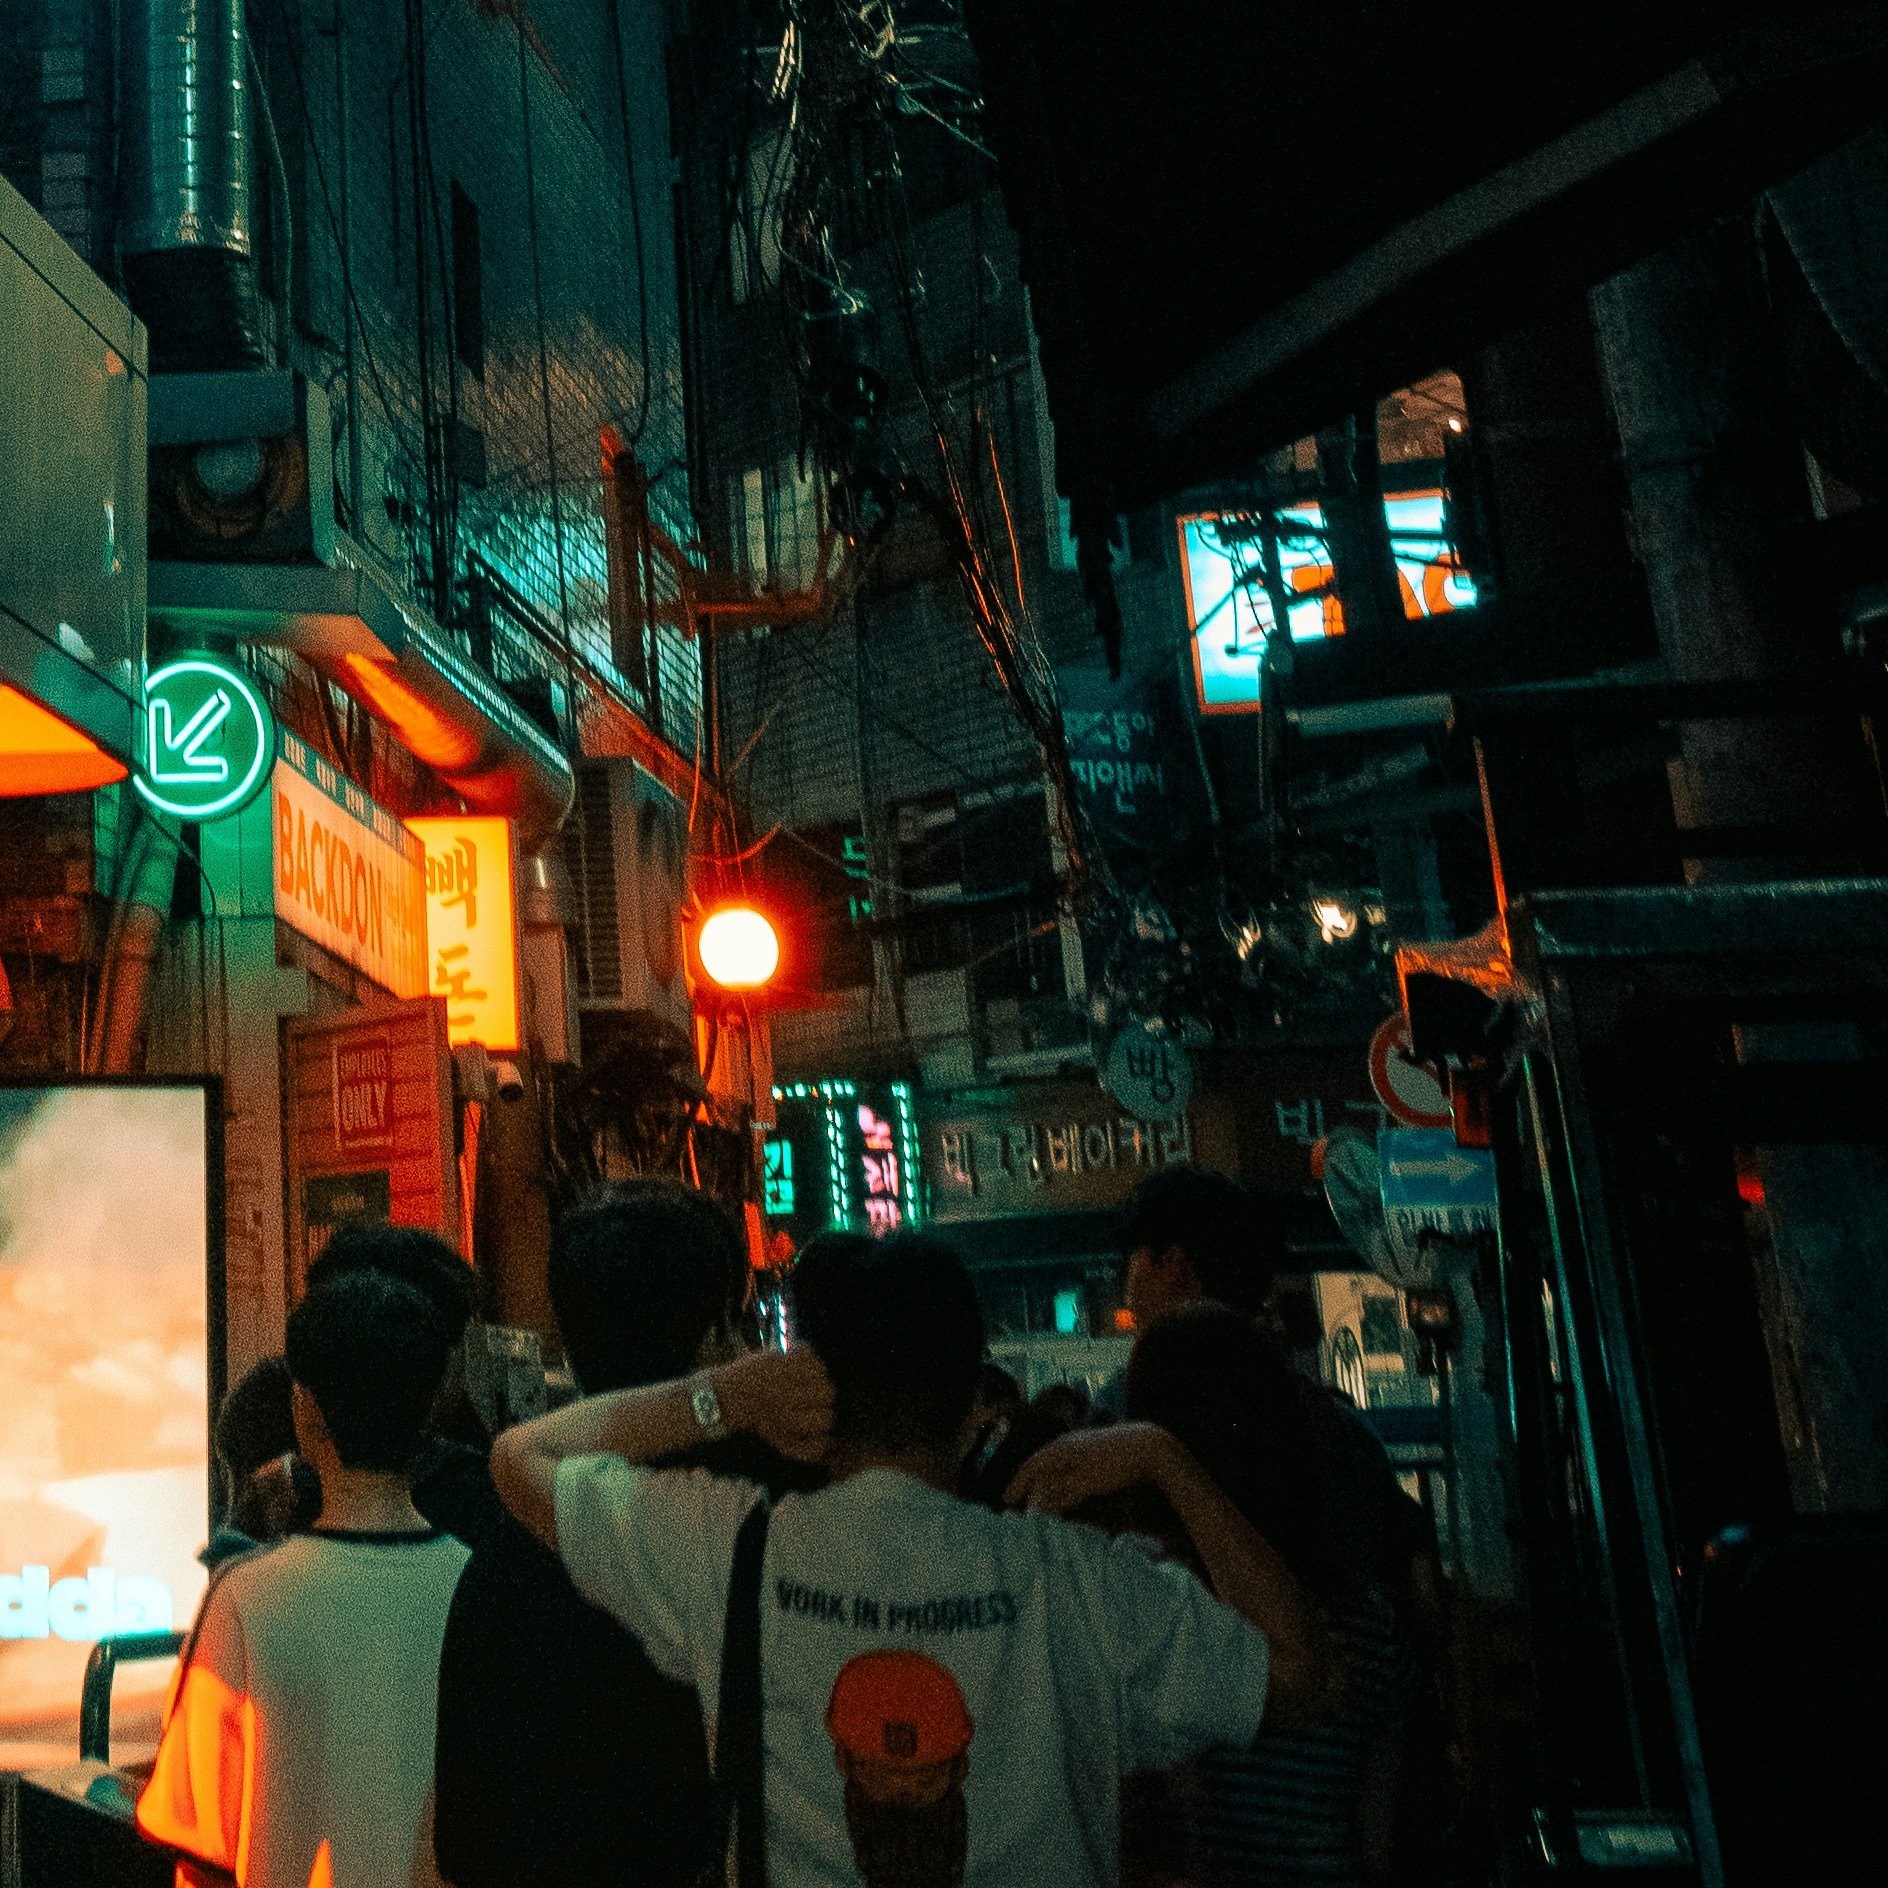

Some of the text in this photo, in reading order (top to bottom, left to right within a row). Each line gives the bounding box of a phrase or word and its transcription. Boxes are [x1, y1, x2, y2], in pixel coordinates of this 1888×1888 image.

[278, 790, 385, 959] BACKDON
[341, 1081, 389, 1132] ONLY
[776, 1576, 1018, 1634] WORK IN PROGRESS
